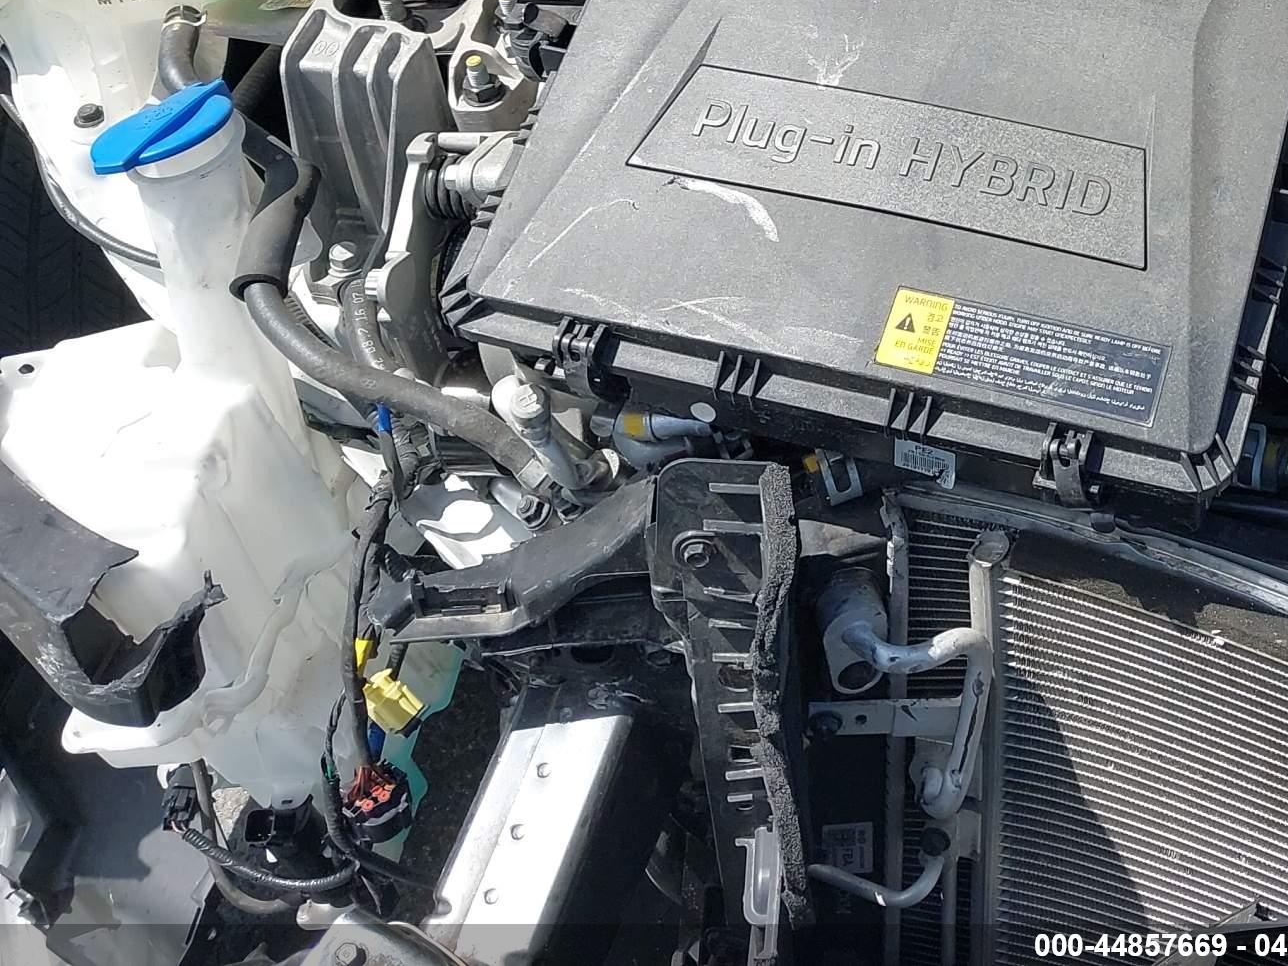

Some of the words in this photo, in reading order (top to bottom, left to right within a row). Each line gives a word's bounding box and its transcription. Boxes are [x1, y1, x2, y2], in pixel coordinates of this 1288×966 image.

[692, 98, 881, 170] Plug-in
[900, 137, 1112, 217] HYBRID
[904, 294, 948, 312] WARNING
[917, 336, 937, 348] MISE
[1094, 335, 1110, 343] READY
[1111, 338, 1125, 346] LAMP
[907, 342, 936, 356] GARDE
